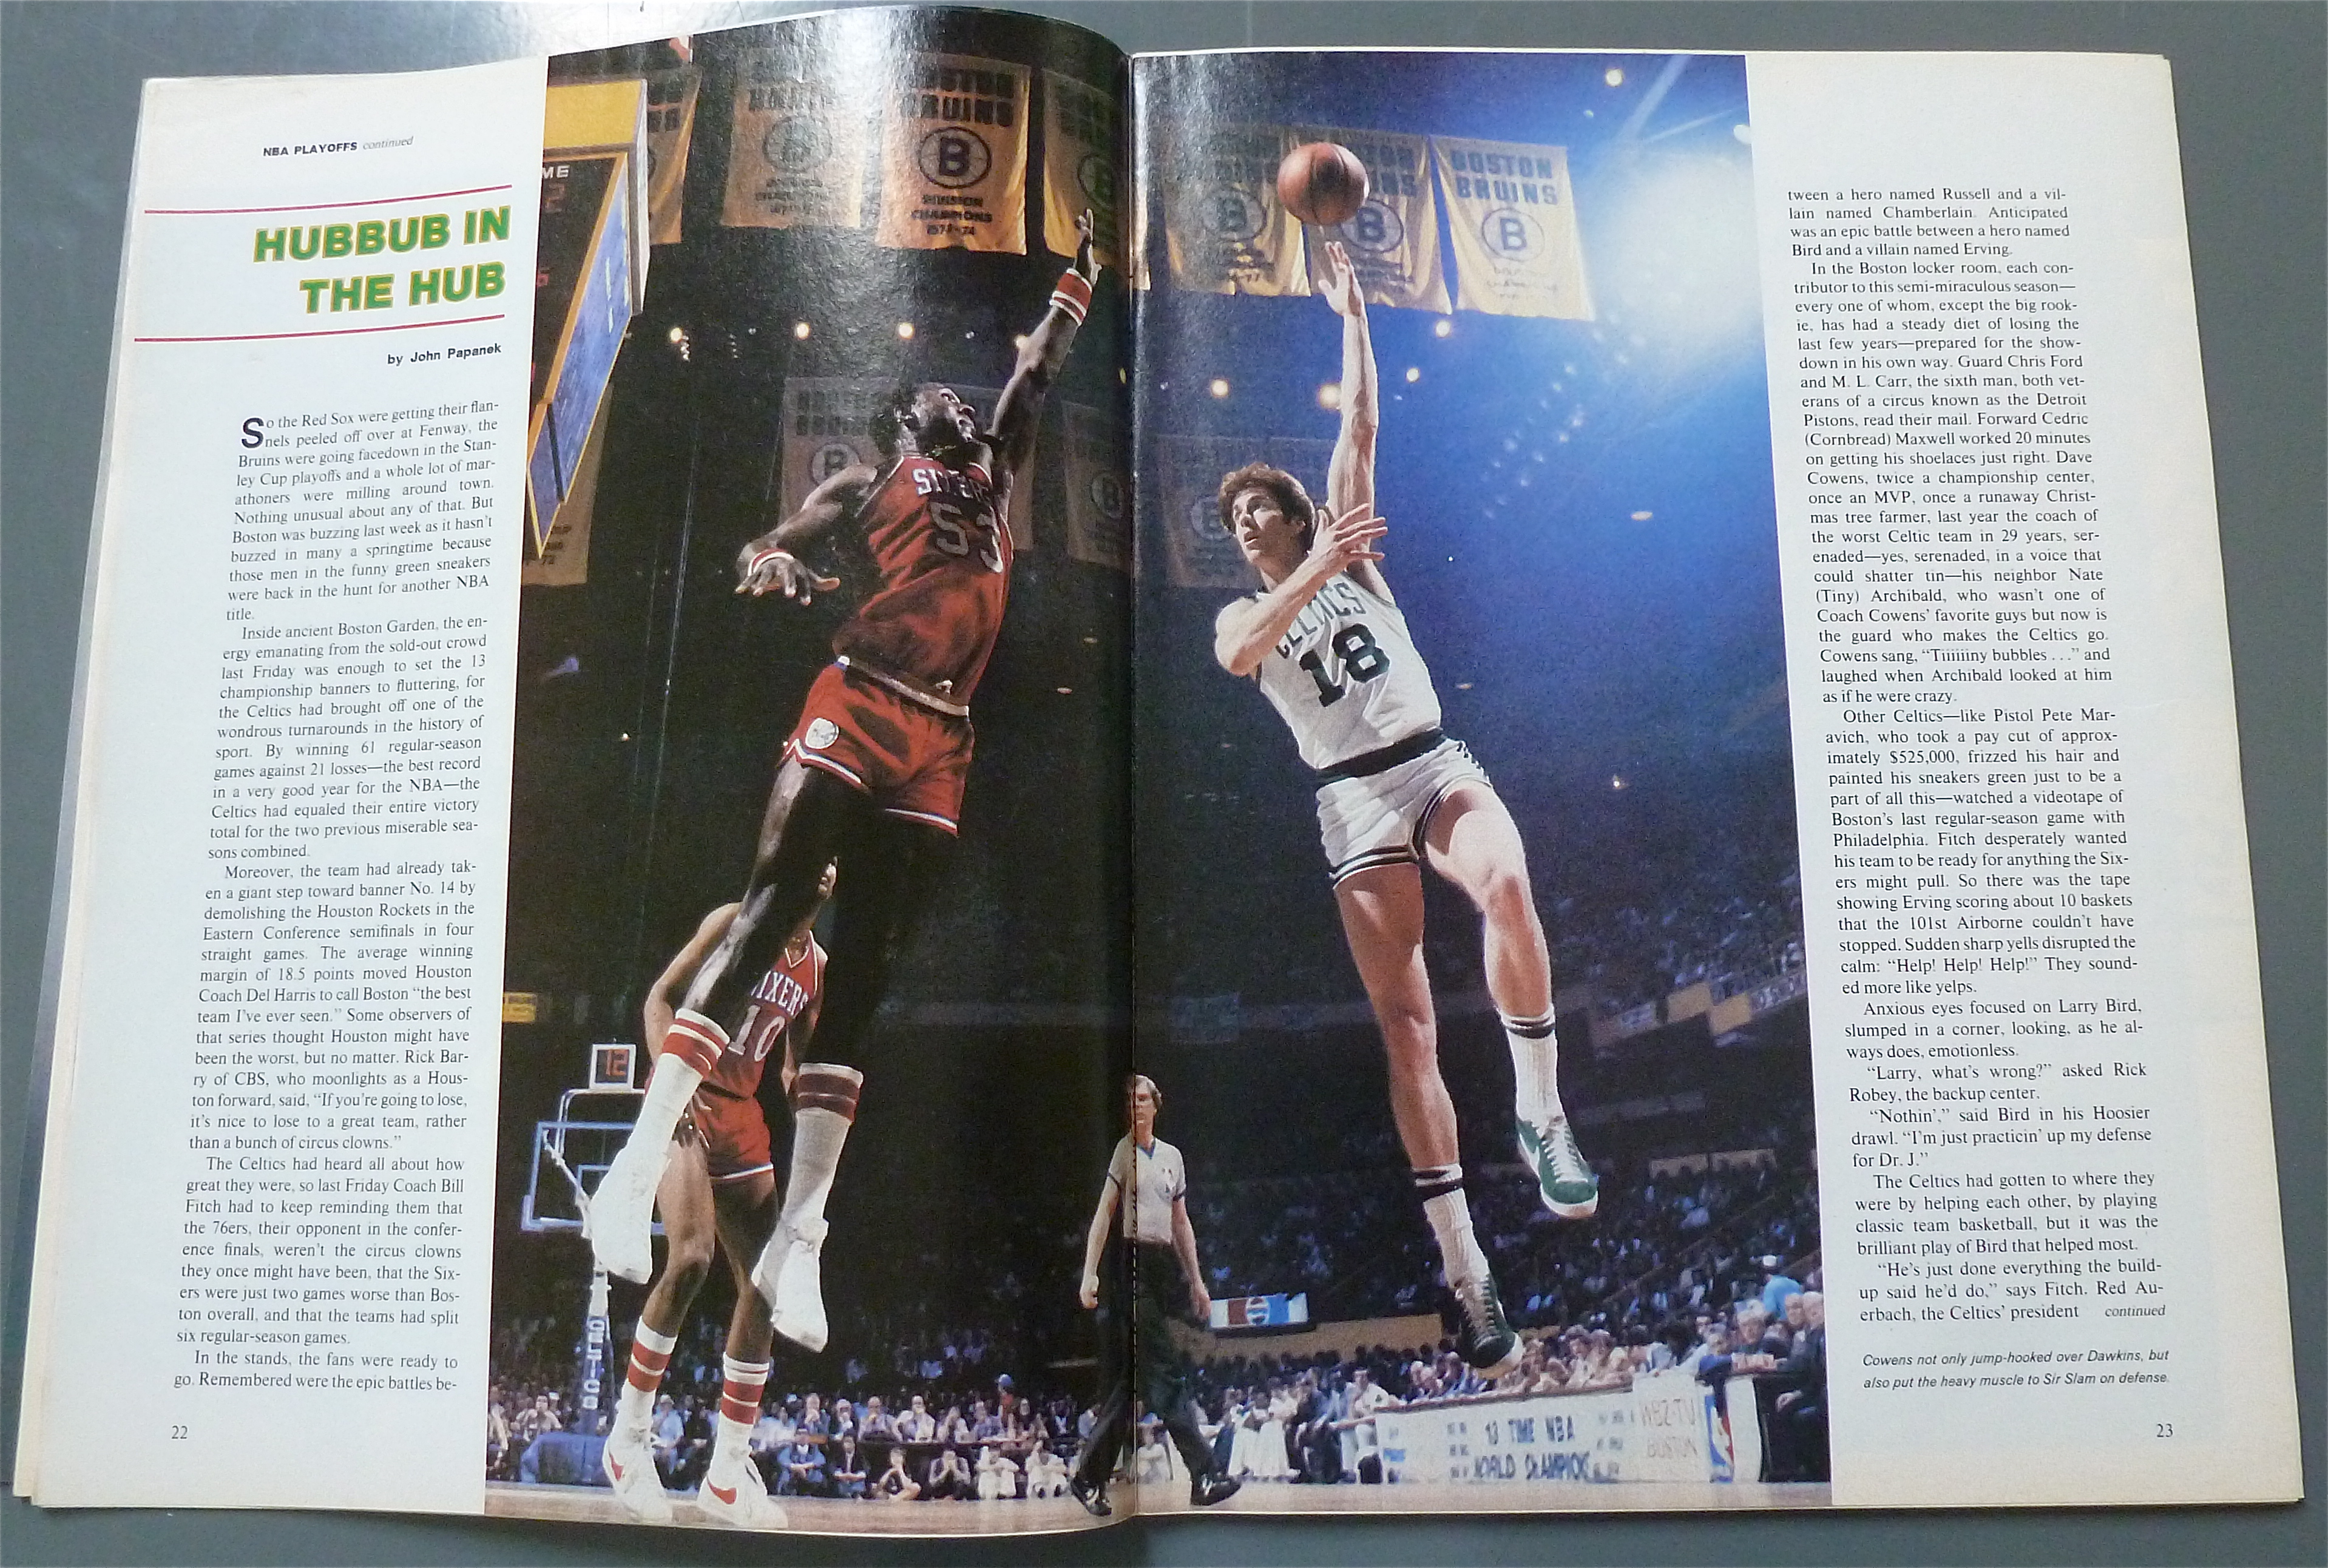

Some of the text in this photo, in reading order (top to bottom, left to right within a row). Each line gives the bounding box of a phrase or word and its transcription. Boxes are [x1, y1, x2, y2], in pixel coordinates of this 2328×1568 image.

[263, 135, 414, 157] NBA PLAYOFFS continued
[939, 137, 969, 177] B
[1450, 150, 1552, 178] BOSTON
[1456, 176, 1558, 206] BRUINS
[1787, 187, 2066, 201] tween a hero named Russell and a vil-
[253, 205, 510, 262] HUBBUB IN
[1357, 207, 1386, 242] B
[1499, 216, 1528, 251] B
[300, 274, 395, 314] THE
[408, 262, 506, 306] HUB
[387, 342, 502, 367] by John Papanek
[278, 416, 297, 428] the
[301, 413, 327, 427] Red
[330, 412, 354, 425] Sox
[357, 412, 388, 422] were
[391, 406, 435, 423] getting
[438, 402, 468, 416] their
[470, 400, 499, 413] flan-
[1810, 508, 2099, 525] mas tree farmer, last year the coach of
[931, 501, 1003, 573] 53
[227, 574, 489, 601] were back in the hunt for another NBA
[1299, 623, 1390, 707] 18
[1821, 667, 2113, 684] laughed when Archibald looked at him
[218, 694, 484, 718] the Celtics had brought off one of the
[211, 797, 479, 819] Celtics had equaled their entire victory
[1832, 830, 2127, 849] Philadelphia. Fitch desperately wanted
[203, 901, 475, 922] demolishing the Houston Rockets in the
[1836, 893, 2133, 911] showing Erving scoring about 10 baskets
[751, 970, 809, 1019] IXERS
[1863, 998, 2142, 1017] Anxious eyes focused on Larry Bird,
[196, 1028, 469, 1046] that series thought Houston might have
[728, 1004, 785, 1062] 10
[605, 1049, 629, 1076] 12
[206, 1155, 464, 1171] The Celtics had heard all about how
[1872, 1170, 2154, 1190] The Celtics had gotten to where they
[1863, 1348, 2170, 1367] Cowens not only jump-hooked over Dawkins, but
[1863, 1371, 2170, 1391] also put the heavy muscle to Sir Slam on defense.
[171, 1425, 188, 1439] 22
[2156, 1423, 2173, 1438] 23
